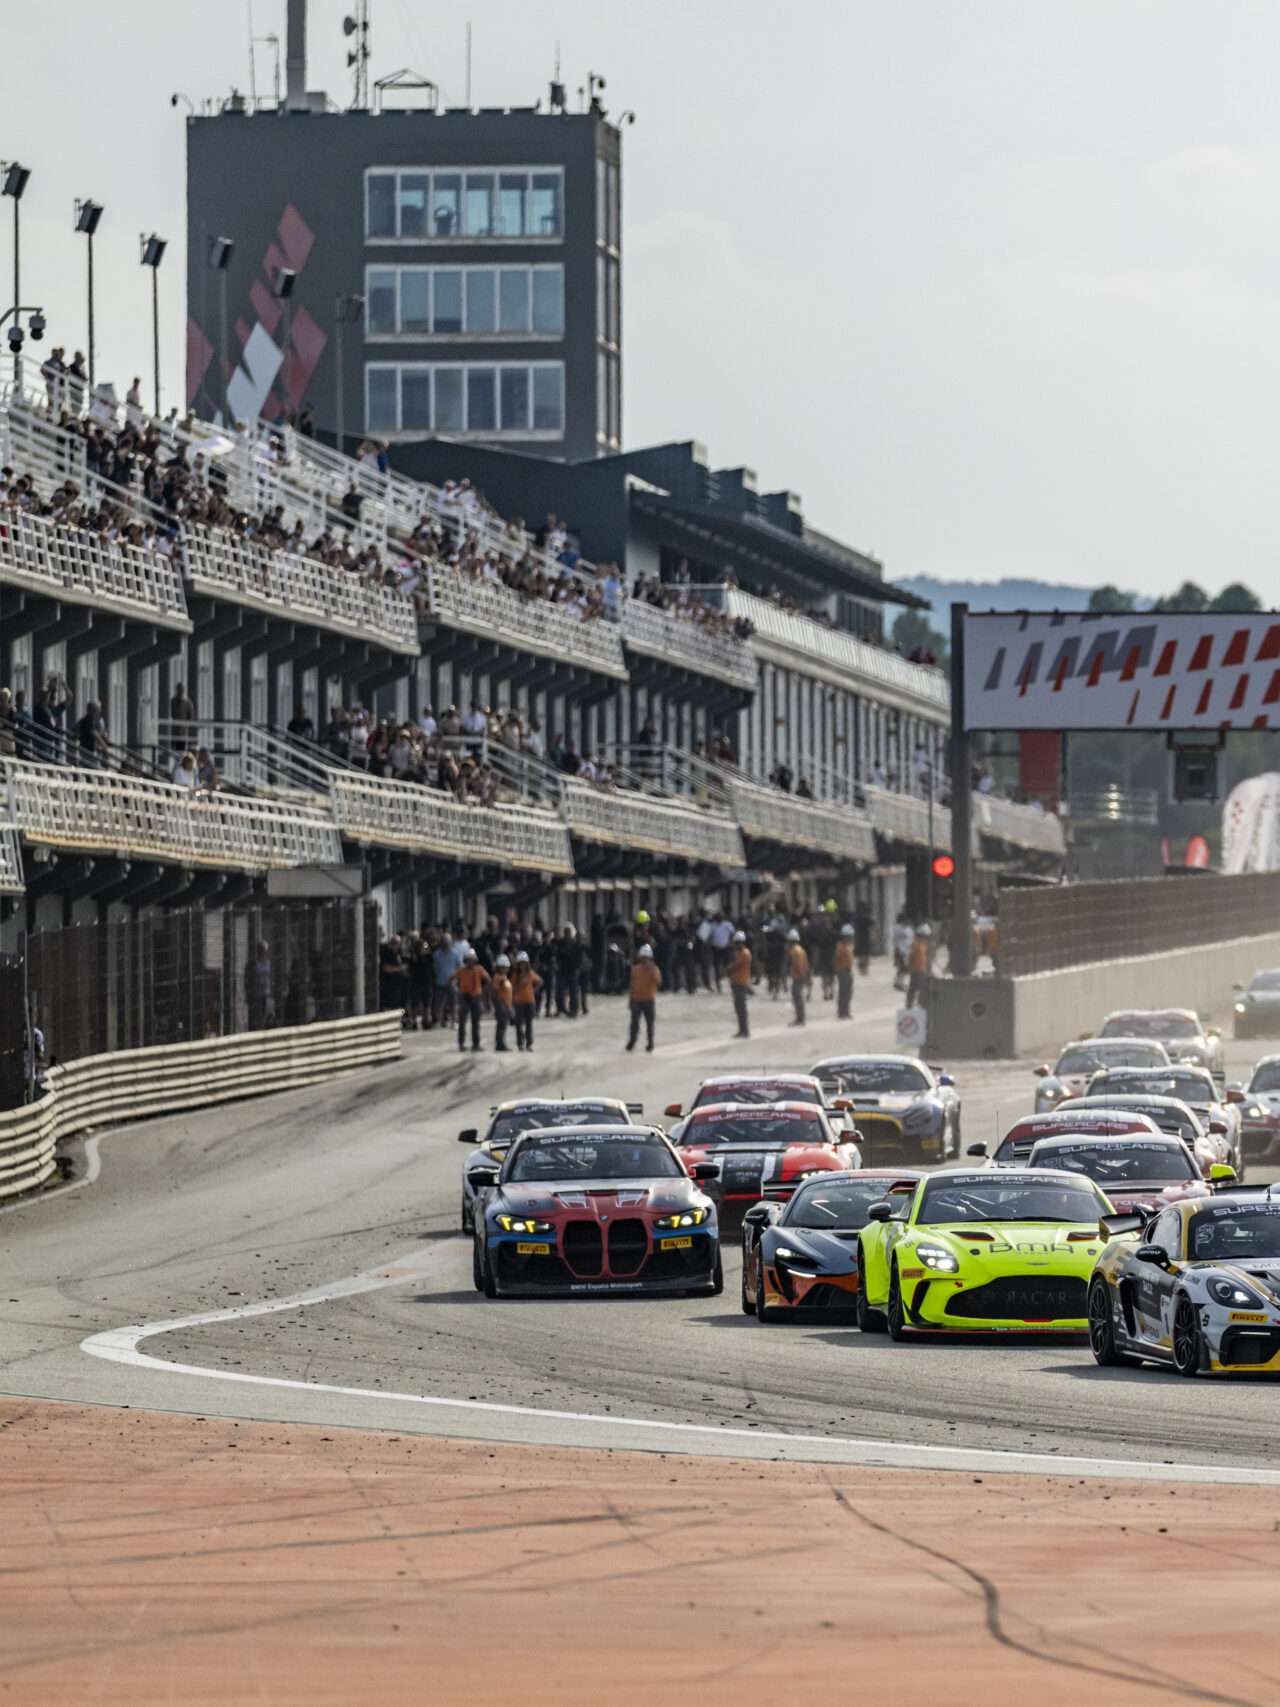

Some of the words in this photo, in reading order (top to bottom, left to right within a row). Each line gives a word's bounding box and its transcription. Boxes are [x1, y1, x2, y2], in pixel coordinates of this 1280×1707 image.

[708, 1111, 802, 1122] SUPERCARS
[1031, 1121, 1129, 1132] SUPERCARS
[540, 1134, 646, 1145] SUPERCARS
[1058, 1143, 1168, 1154] SUPERCARS
[953, 1175, 1070, 1185] SUPERCARS
[610, 1281, 643, 1290] Motorsport
[1231, 1313, 1265, 1322] PIRELLI
